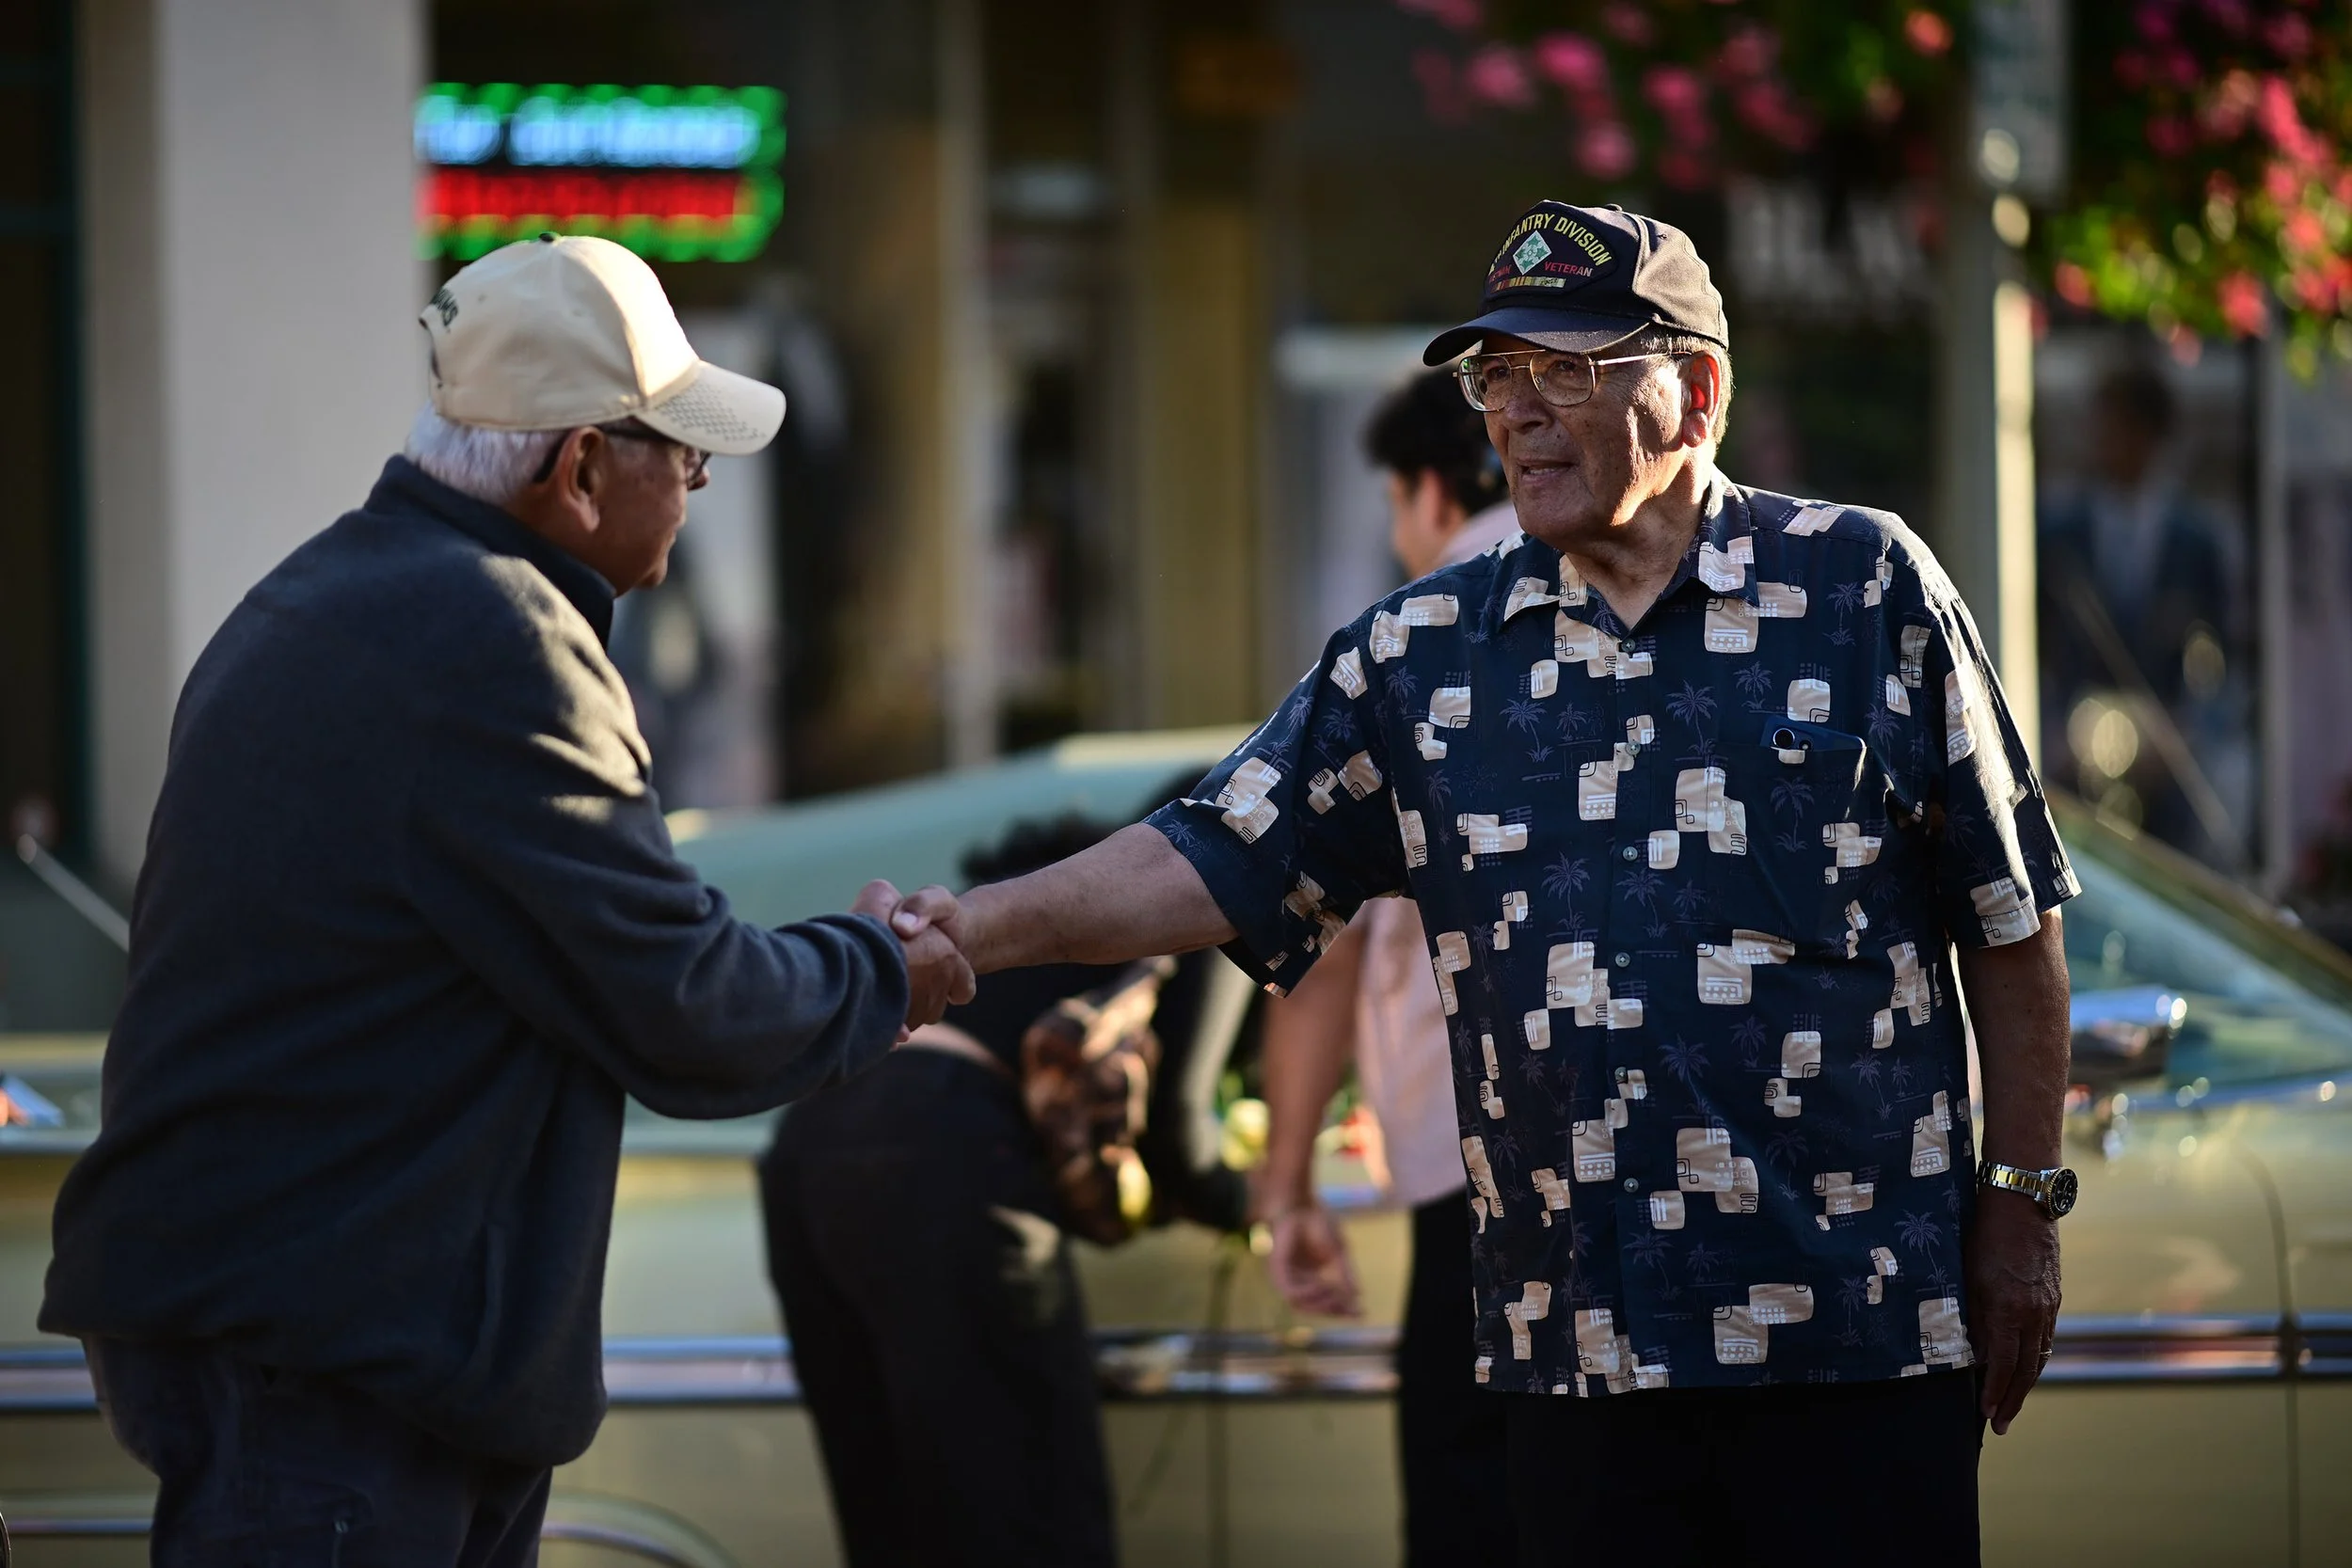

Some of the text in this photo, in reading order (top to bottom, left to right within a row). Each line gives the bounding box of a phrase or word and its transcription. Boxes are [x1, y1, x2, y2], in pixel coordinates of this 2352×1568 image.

[1503, 213, 1554, 253] INFANTRY
[1554, 217, 1612, 265] DIVISION
[1545, 261, 1594, 277] VETERAN
